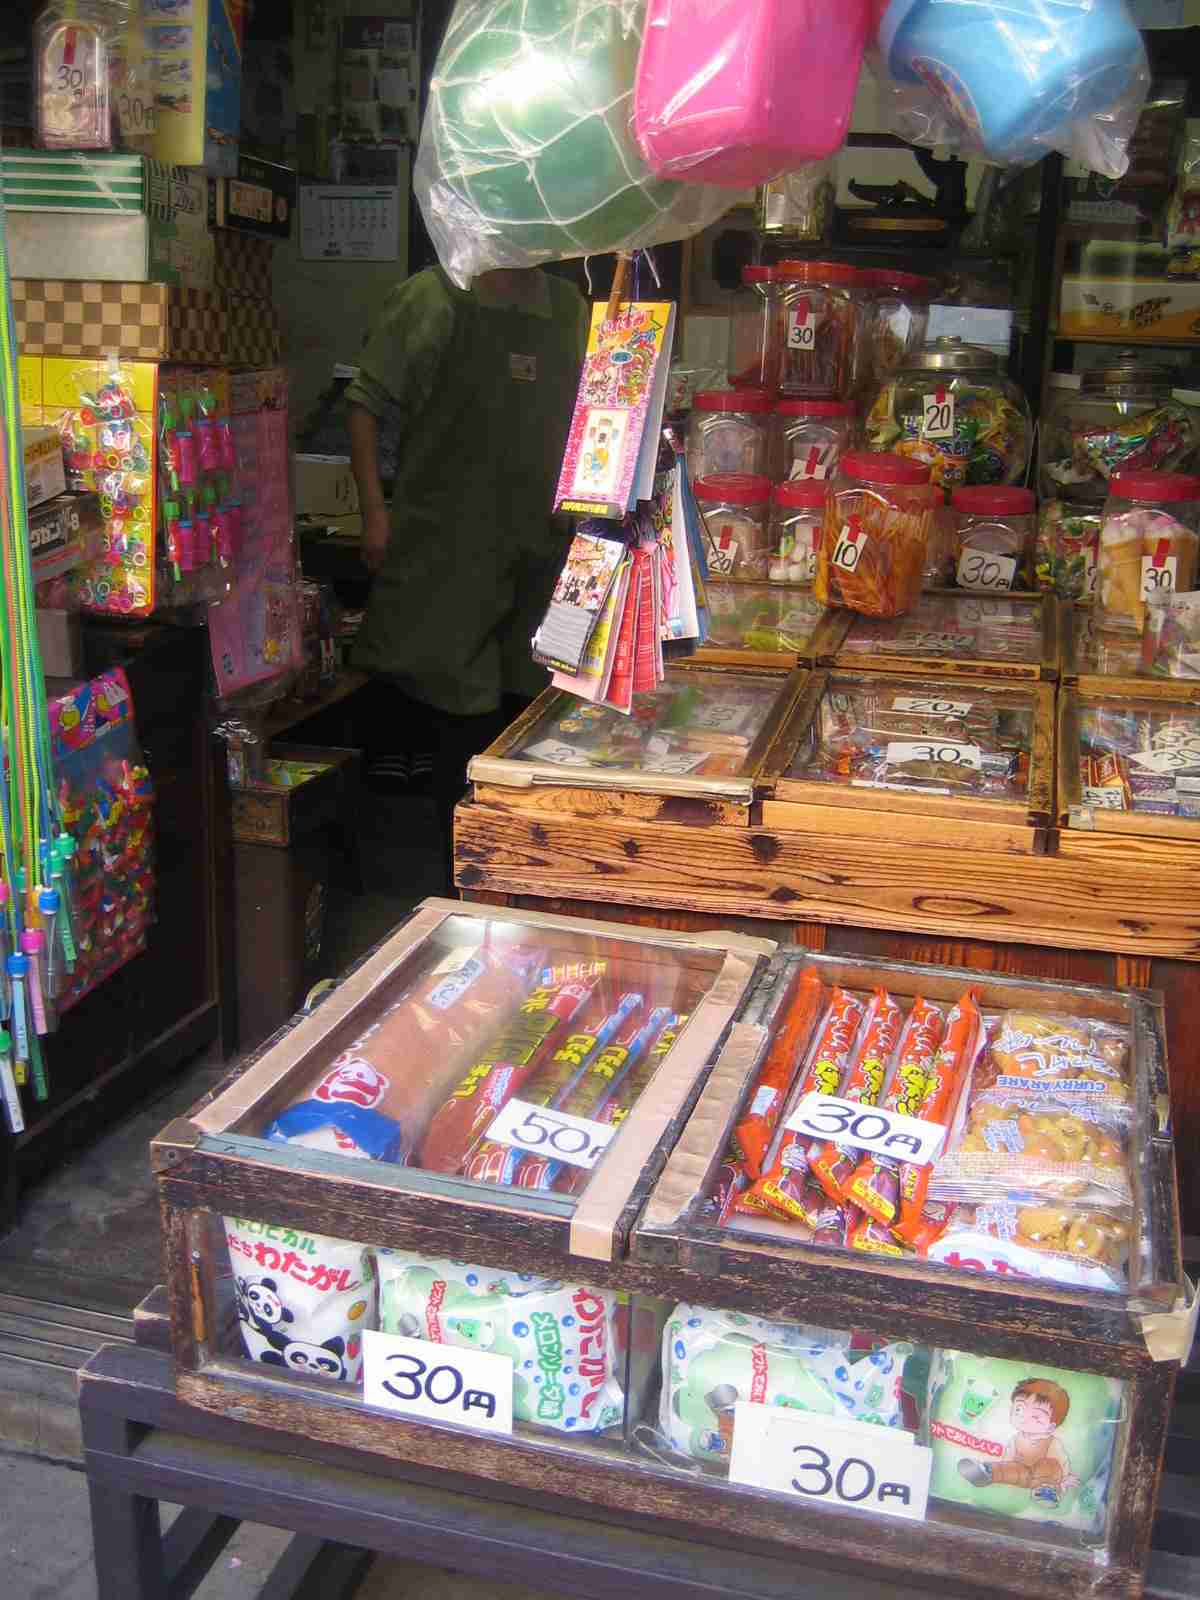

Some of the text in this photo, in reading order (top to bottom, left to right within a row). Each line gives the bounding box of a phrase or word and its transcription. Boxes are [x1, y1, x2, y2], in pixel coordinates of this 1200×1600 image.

[791, 326, 813, 344] 30
[926, 404, 950, 432] 20
[834, 542, 858, 567] 10
[1144, 567, 1172, 593] 30
[1052, 1080, 1106, 1093] CURRY
[802, 1102, 922, 1155] 30円
[573, 1287, 608, 1419] わたがし
[381, 1353, 497, 1418] 30円
[790, 1444, 911, 1506] 30円
